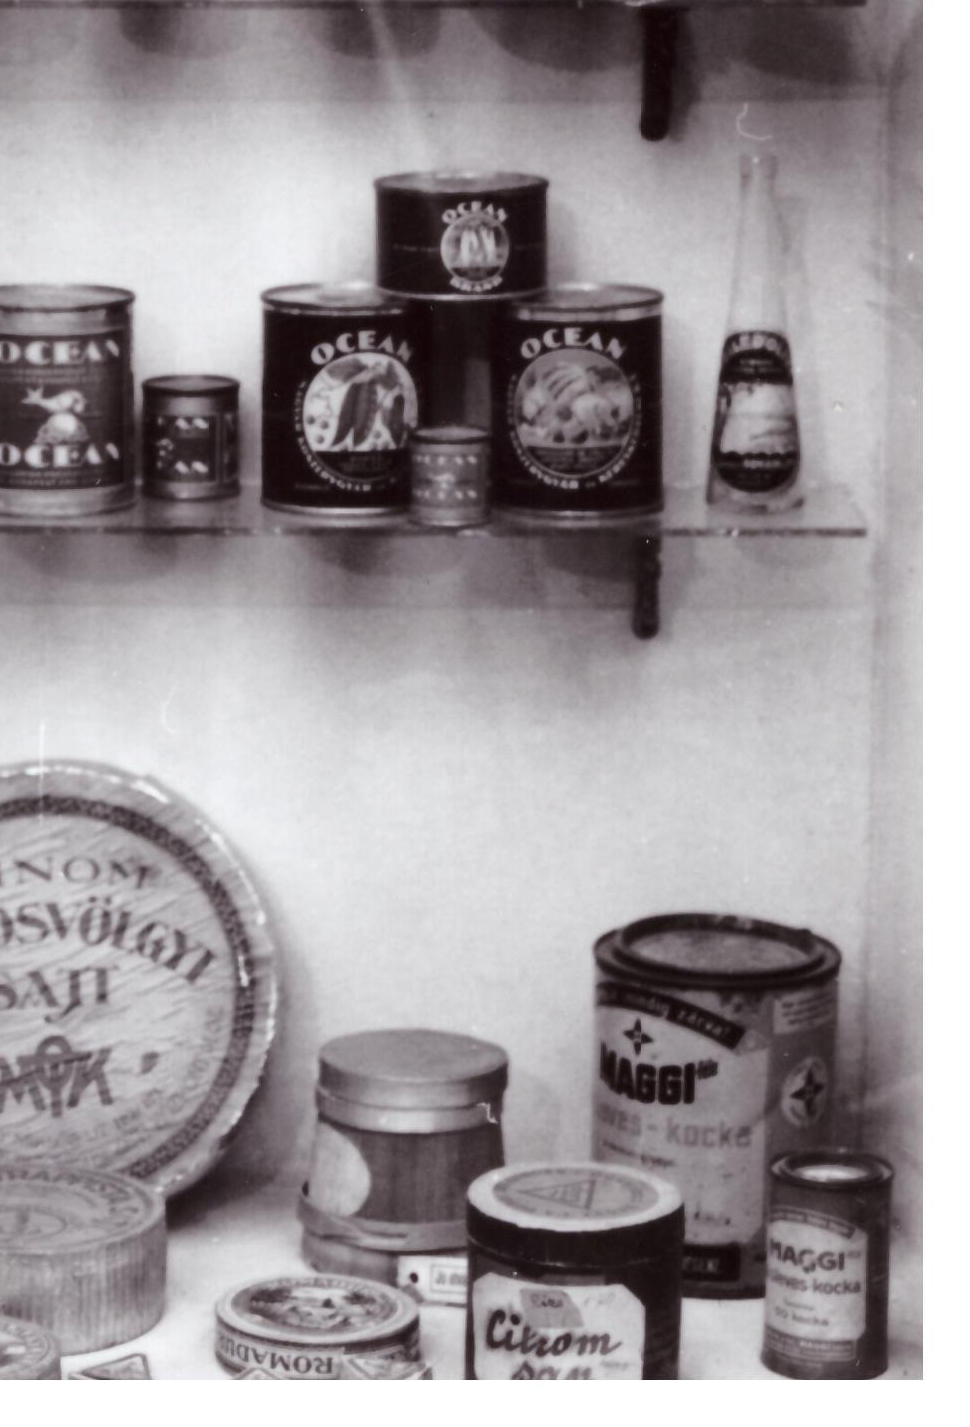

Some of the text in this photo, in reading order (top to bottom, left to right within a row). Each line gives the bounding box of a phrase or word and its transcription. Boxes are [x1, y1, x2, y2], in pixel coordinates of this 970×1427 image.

[310, 329, 414, 366] OCEAN
[520, 327, 627, 360] OCEAN
[600, 1043, 695, 1105] MAGGI
[666, 1116, 752, 1148] kocka
[486, 1309, 623, 1357] Citrom
